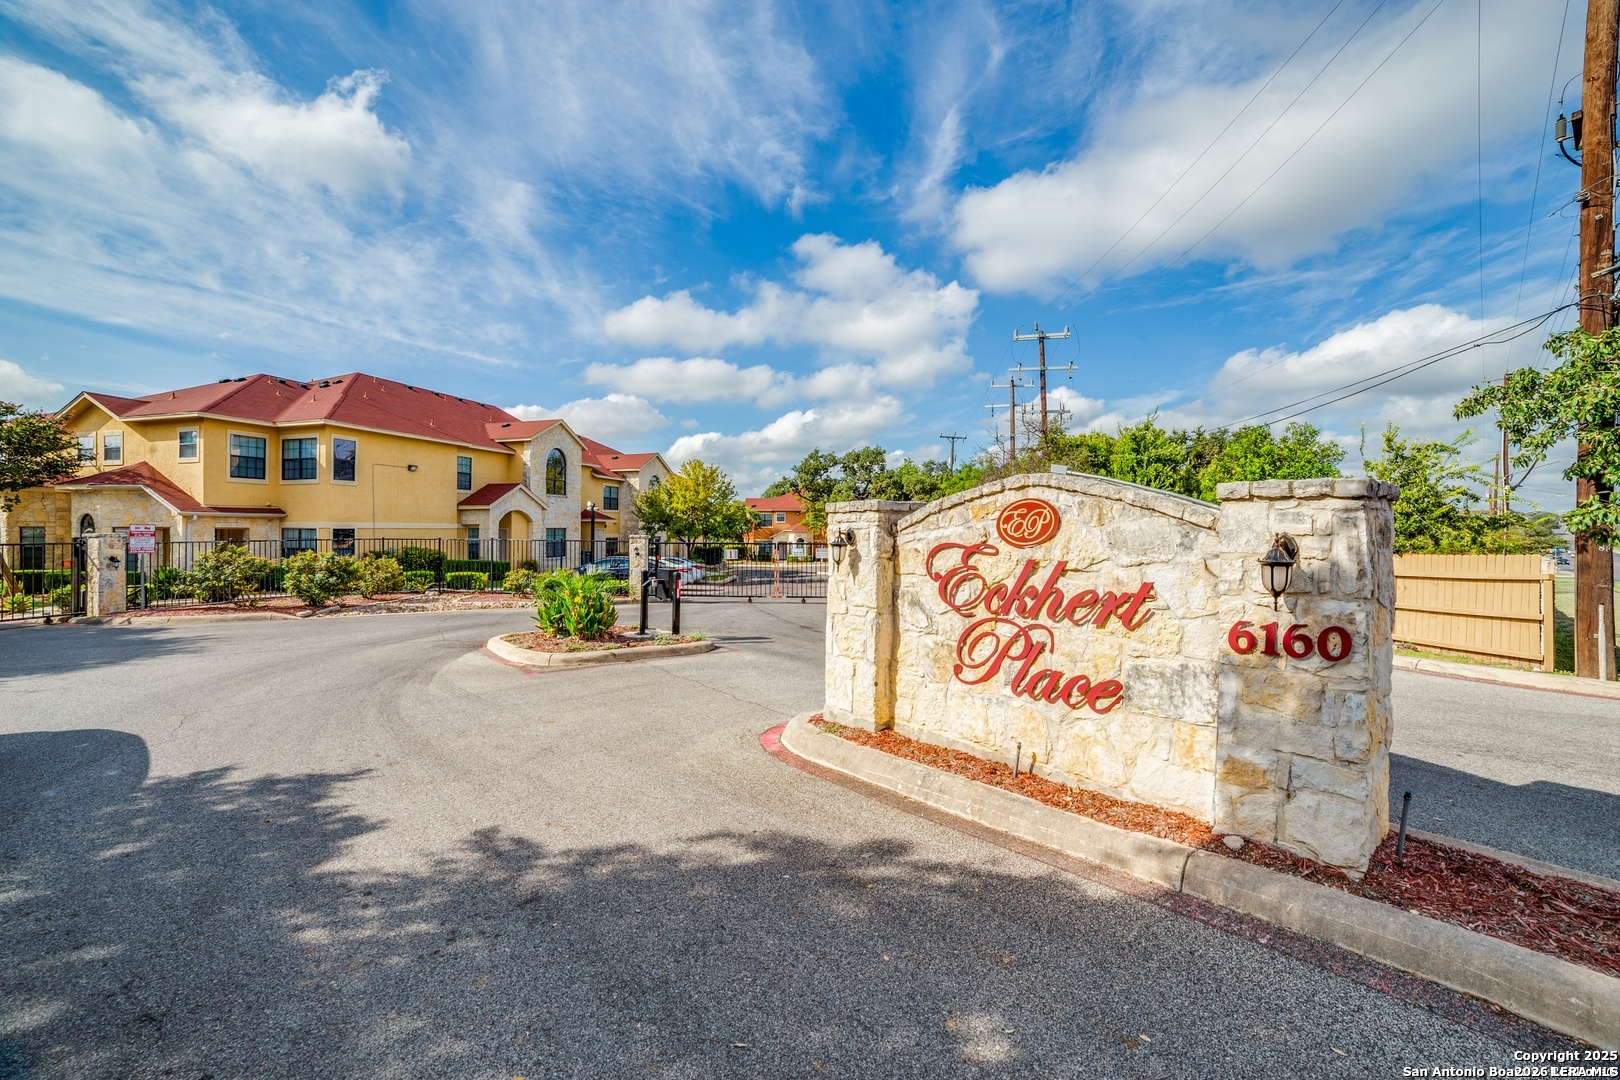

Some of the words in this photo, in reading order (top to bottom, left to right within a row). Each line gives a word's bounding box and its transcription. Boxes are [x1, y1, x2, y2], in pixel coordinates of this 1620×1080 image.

[1001, 507, 1051, 539] EP
[925, 542, 1155, 631] Eckhert
[953, 617, 1125, 715] Place
[1227, 620, 1353, 662] 6160
